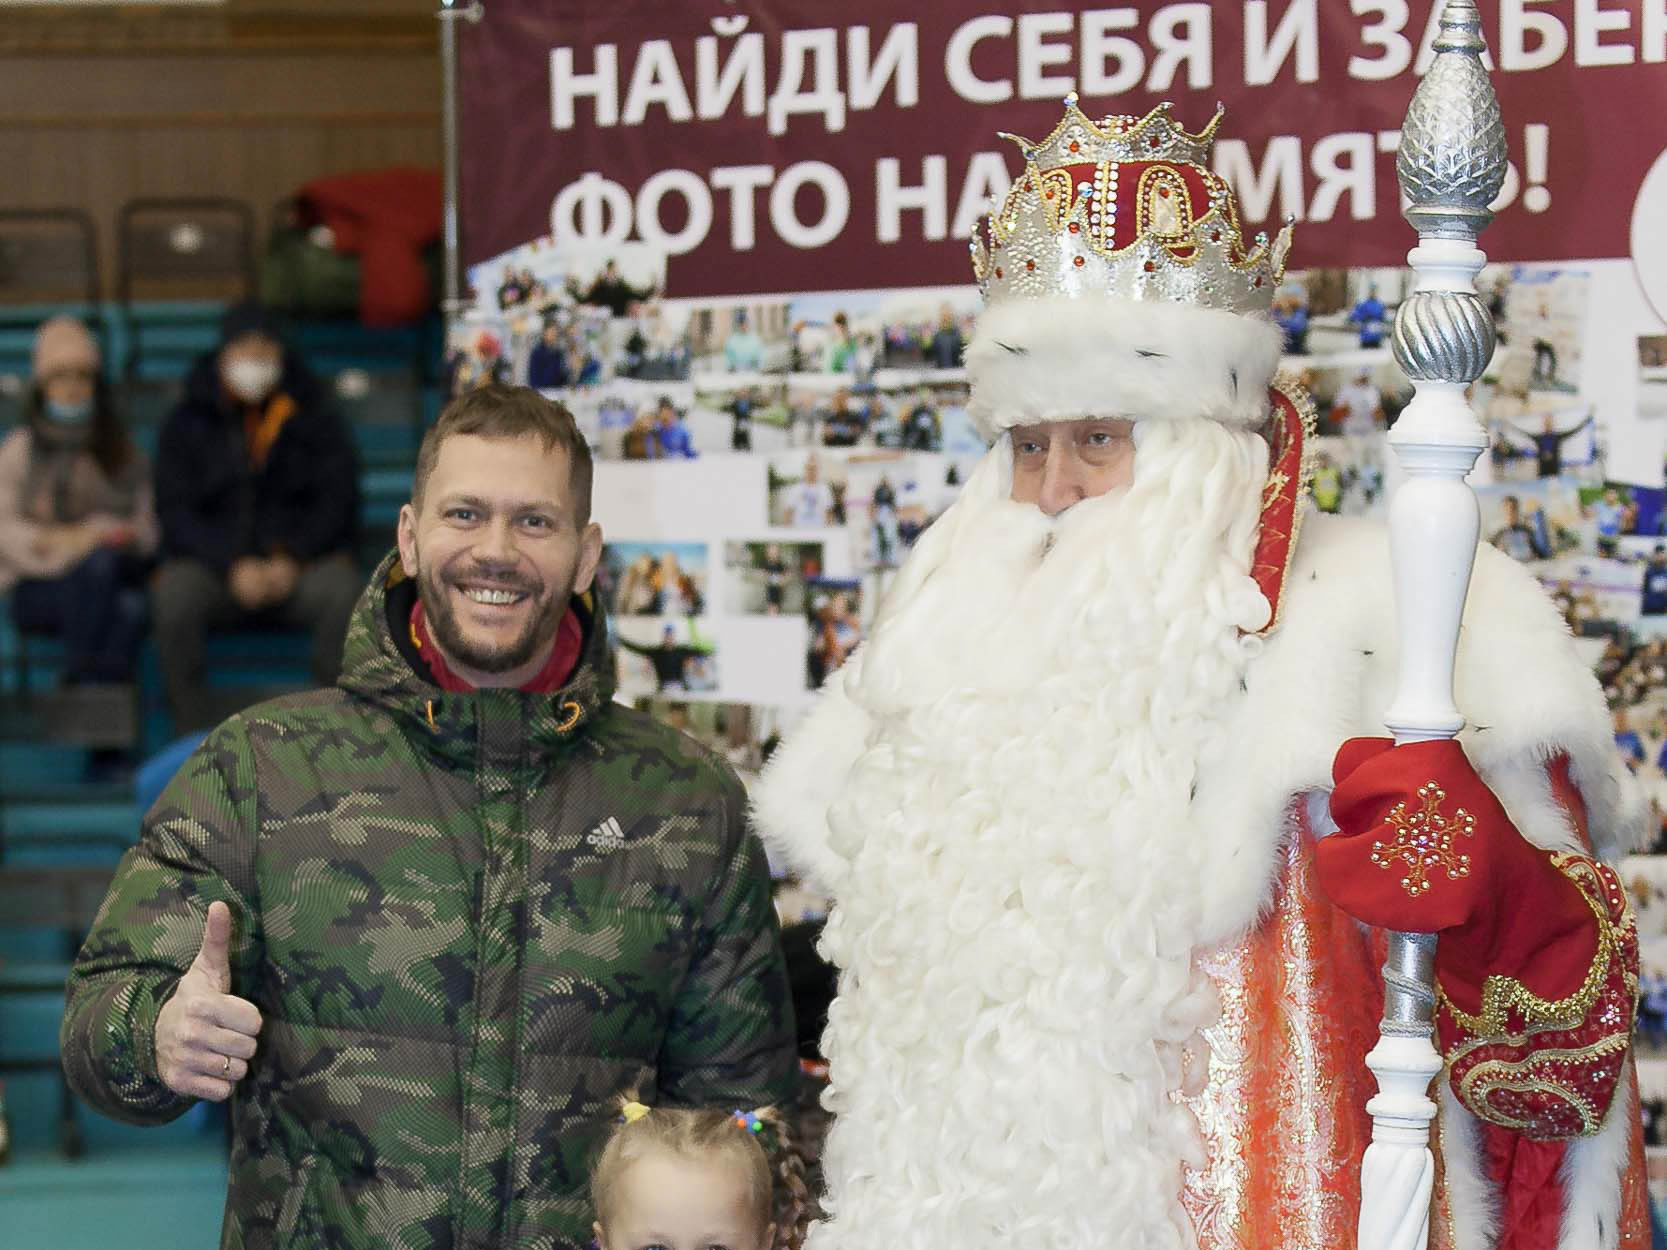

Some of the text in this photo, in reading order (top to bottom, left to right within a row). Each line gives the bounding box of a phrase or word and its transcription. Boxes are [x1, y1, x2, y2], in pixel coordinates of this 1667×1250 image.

[549, 14, 918, 136] НАЙДИ
[944, 3, 1213, 104] СЕБЯ
[1243, 0, 1319, 87] И
[550, 160, 850, 256] ФОТО
[876, 151, 1012, 243] НА
